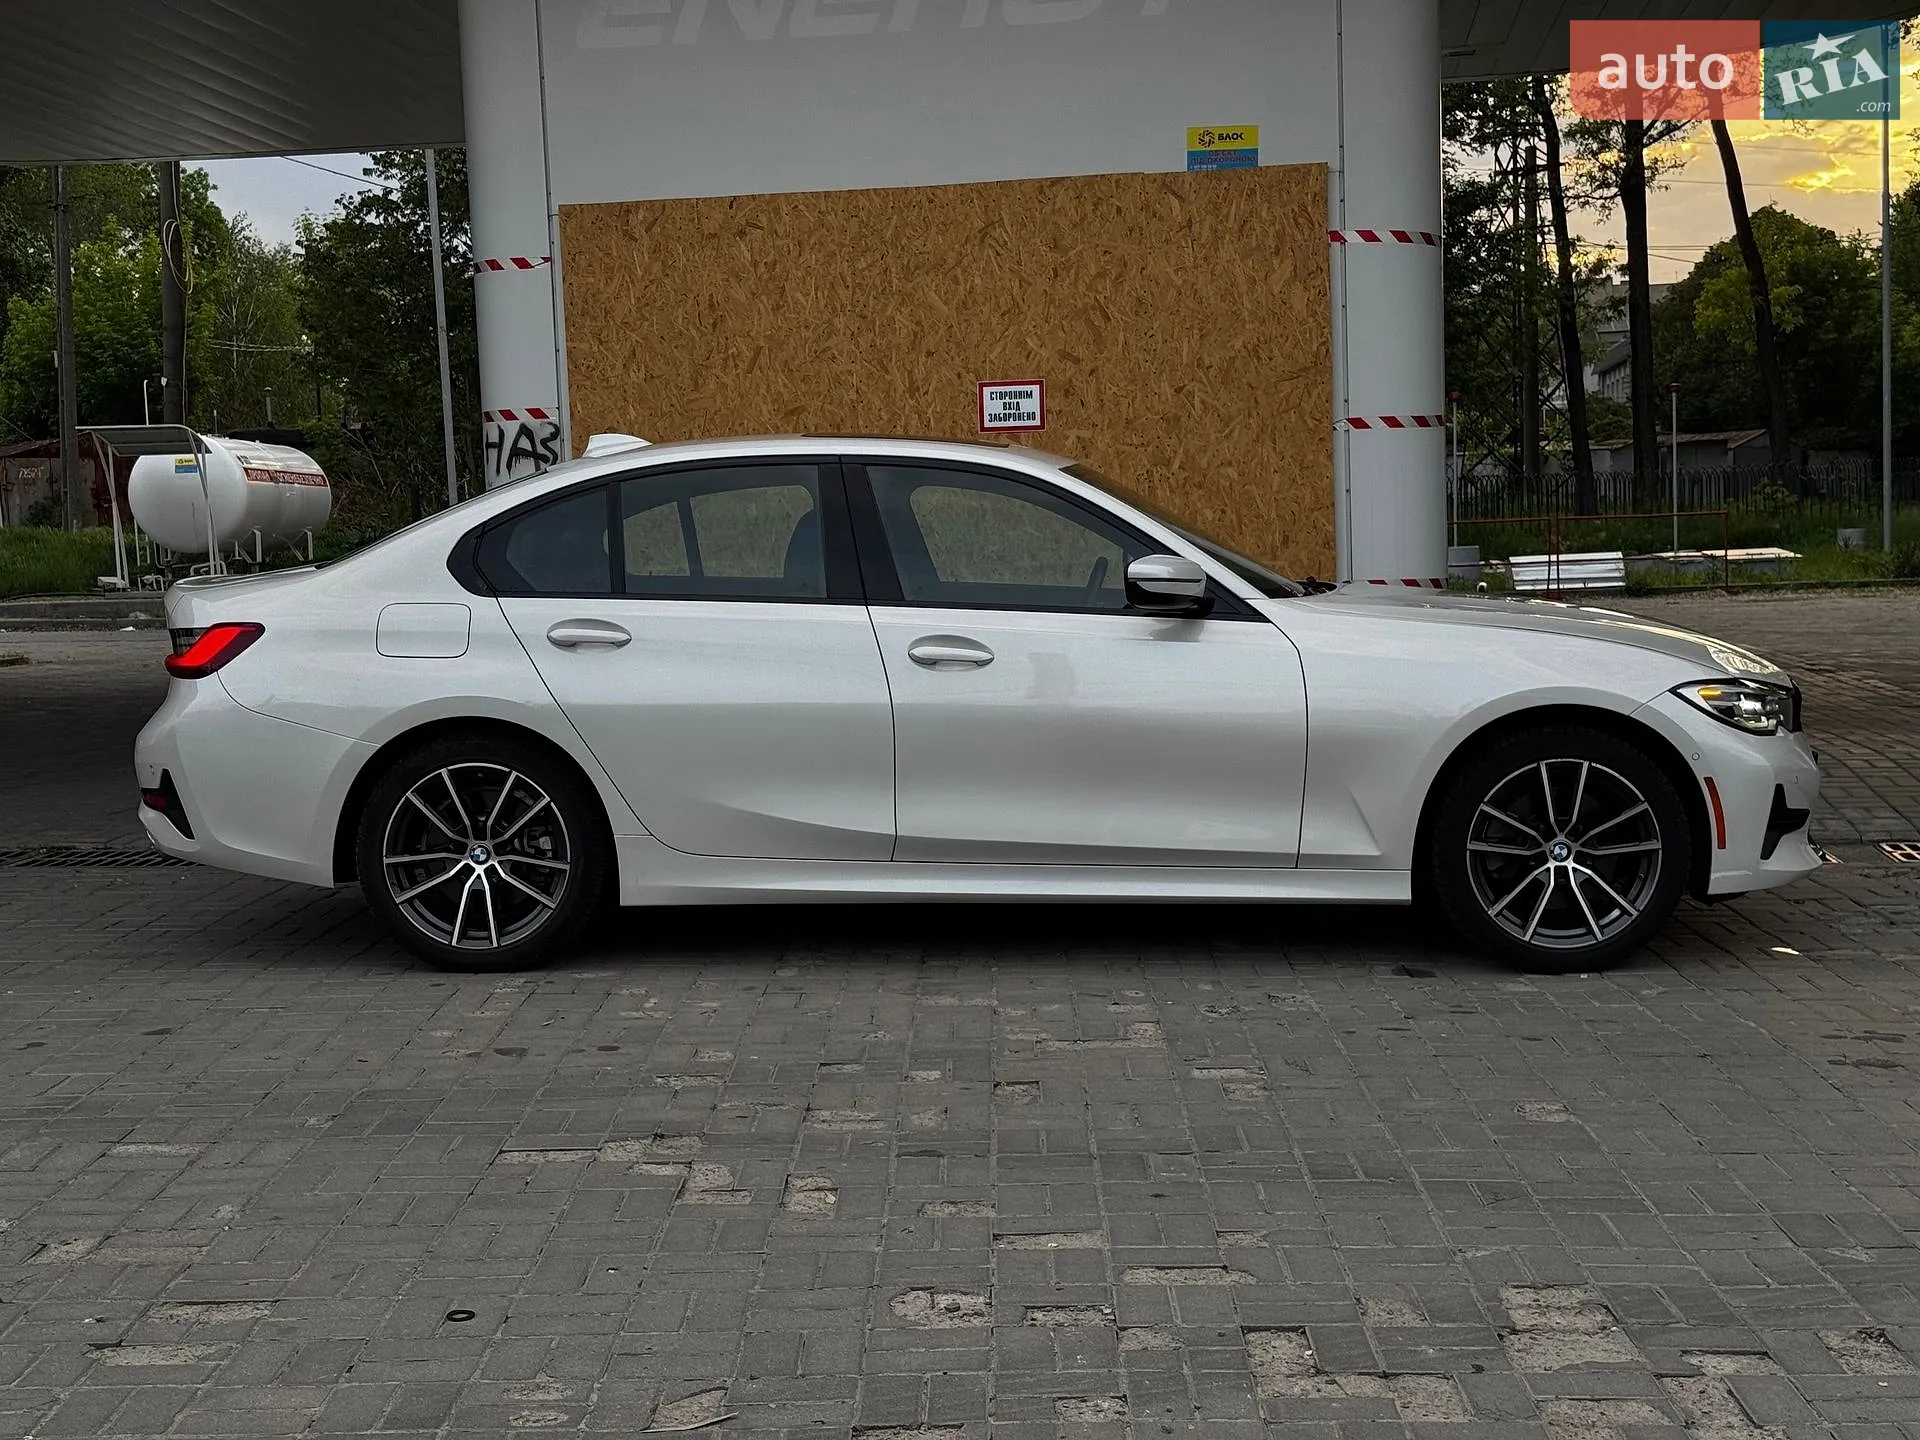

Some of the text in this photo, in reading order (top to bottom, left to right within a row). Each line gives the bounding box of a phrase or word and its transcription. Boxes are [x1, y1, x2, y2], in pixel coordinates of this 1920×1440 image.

[1217, 132, 1245, 141] БЛОК
[989, 390, 1033, 401] СТОРОННІМ
[1002, 401, 1021, 411] ВХІД
[988, 411, 1036, 422] ЗАБОРОНЕНО
